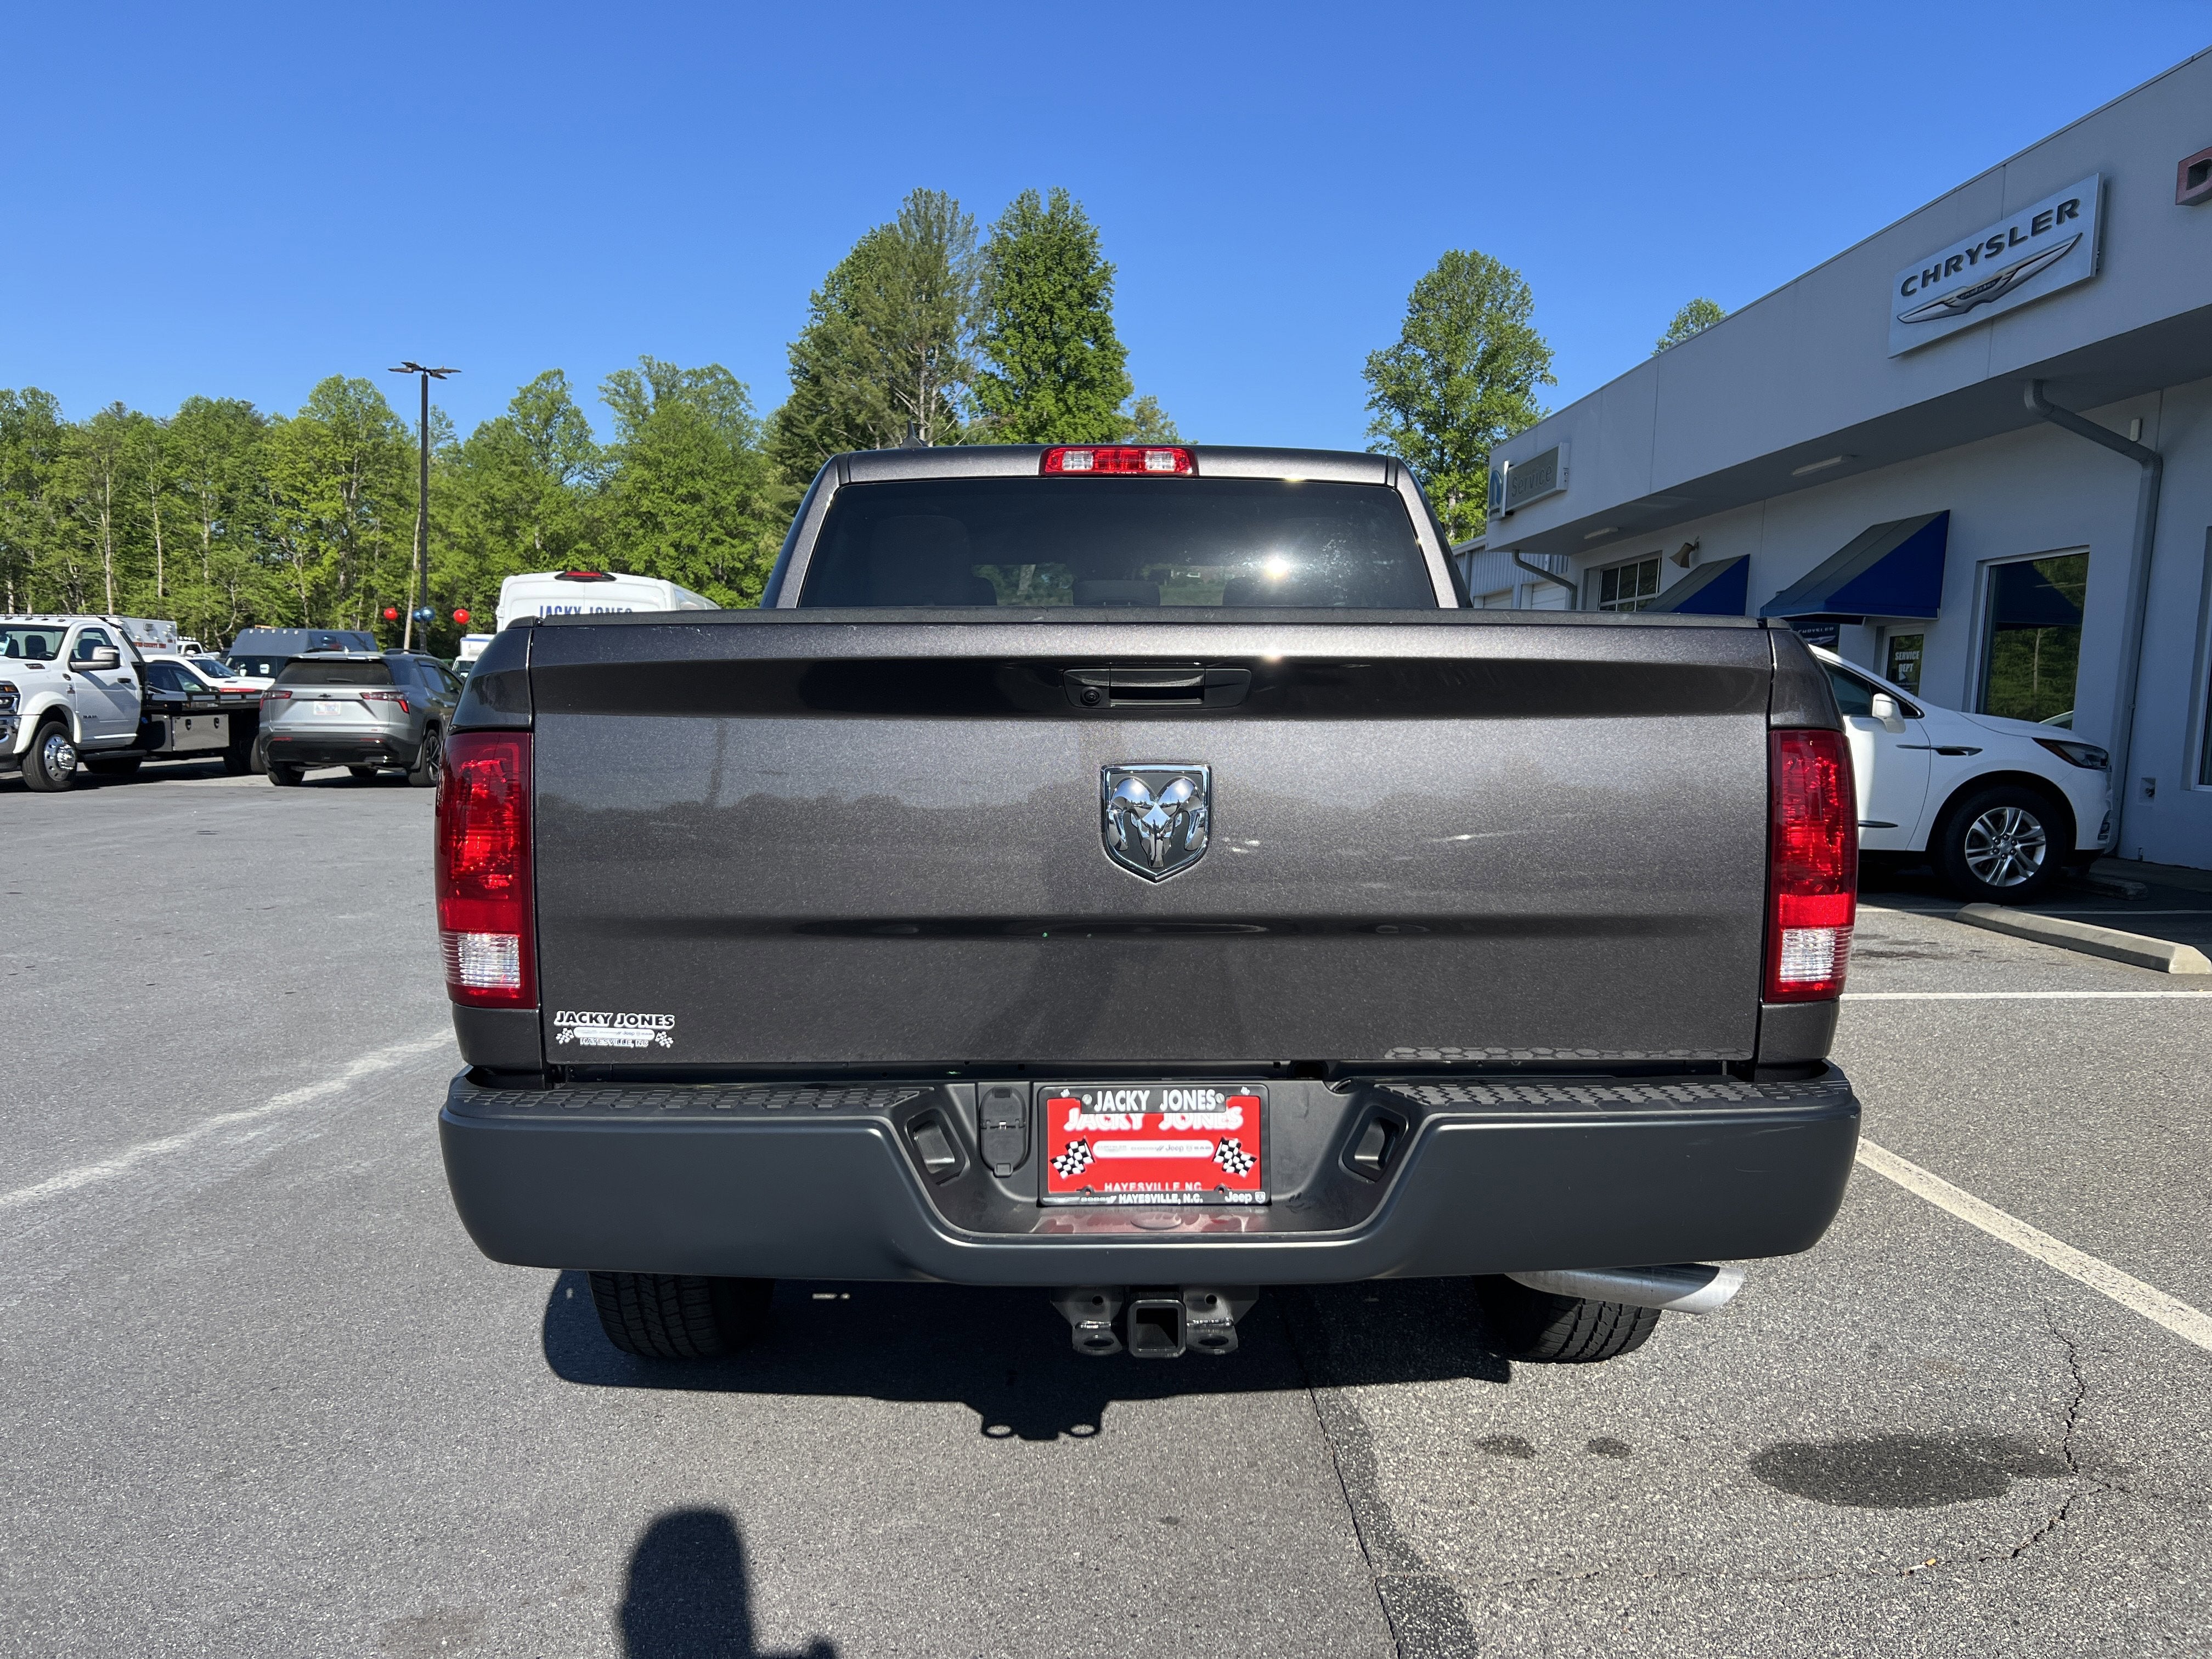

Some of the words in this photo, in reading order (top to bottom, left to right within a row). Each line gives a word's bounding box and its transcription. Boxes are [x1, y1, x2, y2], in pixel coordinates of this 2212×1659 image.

[1900, 198, 2080, 297] CHRYSLER
[1511, 466, 1552, 496] Service
[1895, 651, 1920, 661] SERVICE
[1899, 663, 1914, 673] DEPT
[554, 1011, 613, 1028] JACKY
[614, 1013, 675, 1030] JONES
[580, 1037, 634, 1048] HAYESVILLE,
[635, 1040, 649, 1048] NC
[1094, 1090, 1150, 1112] JACKY
[1160, 1089, 1216, 1111] JONES
[1063, 1107, 1145, 1131] JACKY
[1158, 1105, 1244, 1131] JONES
[1104, 1182, 1180, 1192] HAYESVILLE
[1119, 1193, 1181, 1204] HAYESVILLE,
[1183, 1193, 1203, 1203] N.C.
[1224, 1191, 1252, 1204] Jeep
